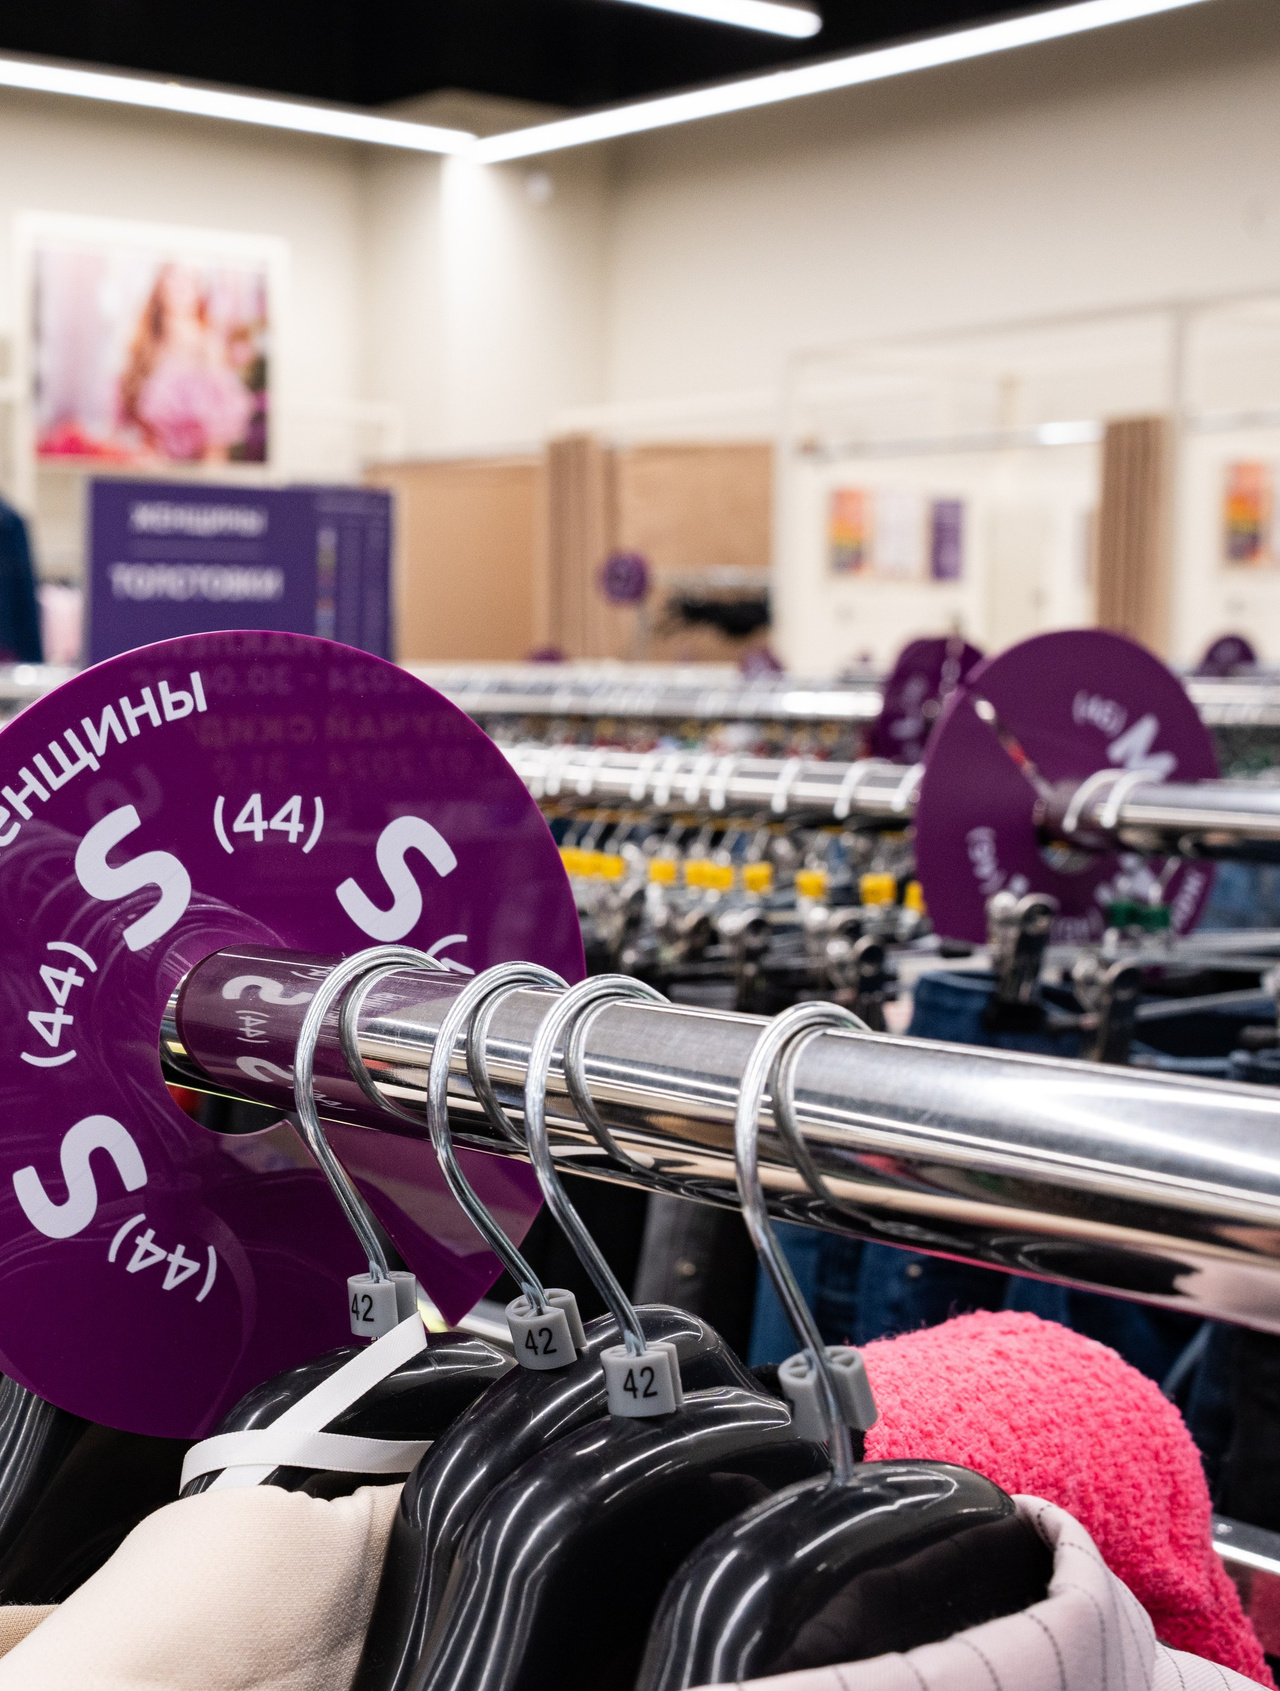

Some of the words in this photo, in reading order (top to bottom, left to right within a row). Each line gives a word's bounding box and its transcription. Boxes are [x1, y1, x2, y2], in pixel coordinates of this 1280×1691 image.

[214, 794, 323, 853] (44)
[75, 805, 191, 951] S
[336, 816, 457, 942] S
[21, 942, 97, 1067] (44)
[13, 1115, 147, 1238] S
[109, 1214, 216, 1301] (44)
[351, 1293, 375, 1323] 42
[524, 1327, 558, 1356] 42
[623, 1366, 658, 1399] 42
